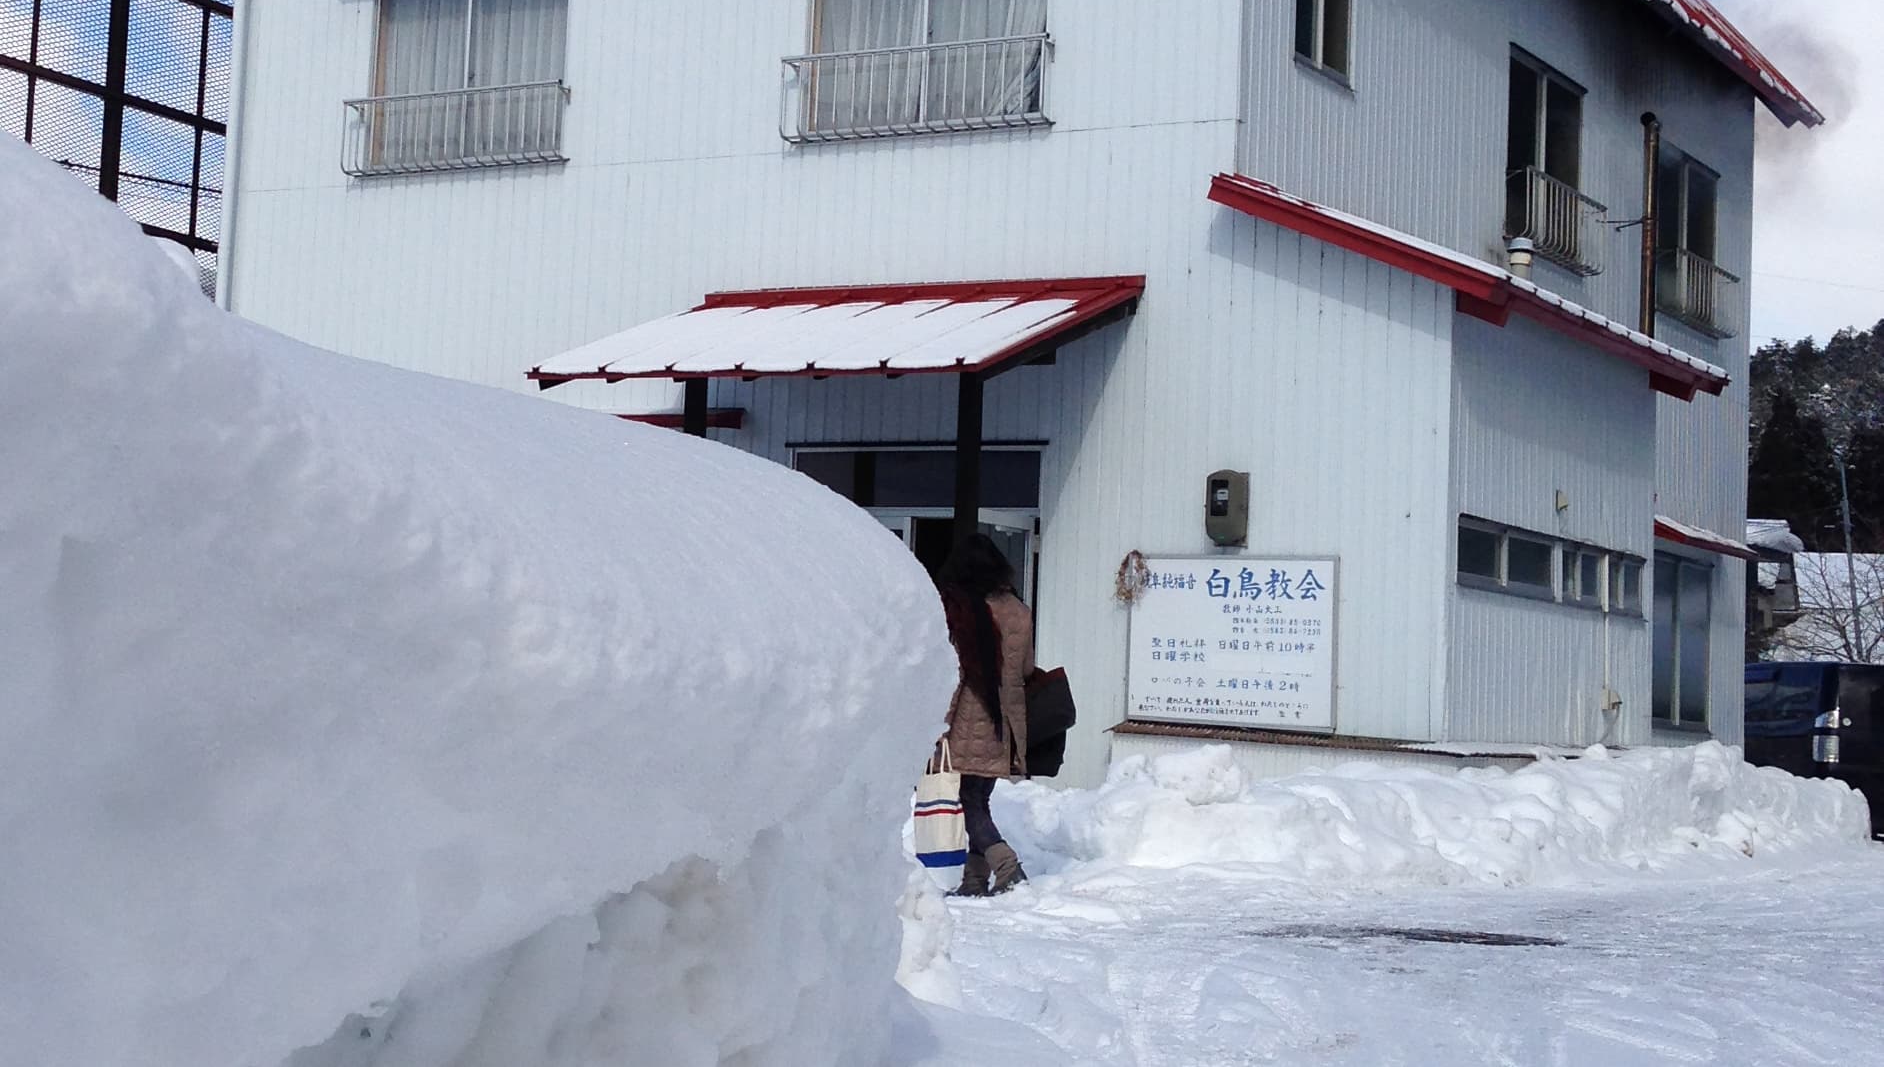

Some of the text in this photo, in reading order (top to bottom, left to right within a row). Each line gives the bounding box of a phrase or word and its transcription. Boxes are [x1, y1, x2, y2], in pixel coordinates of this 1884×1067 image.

[1206, 567, 1326, 601] 白鳥教会
[1152, 651, 1206, 662] 日曜学校
